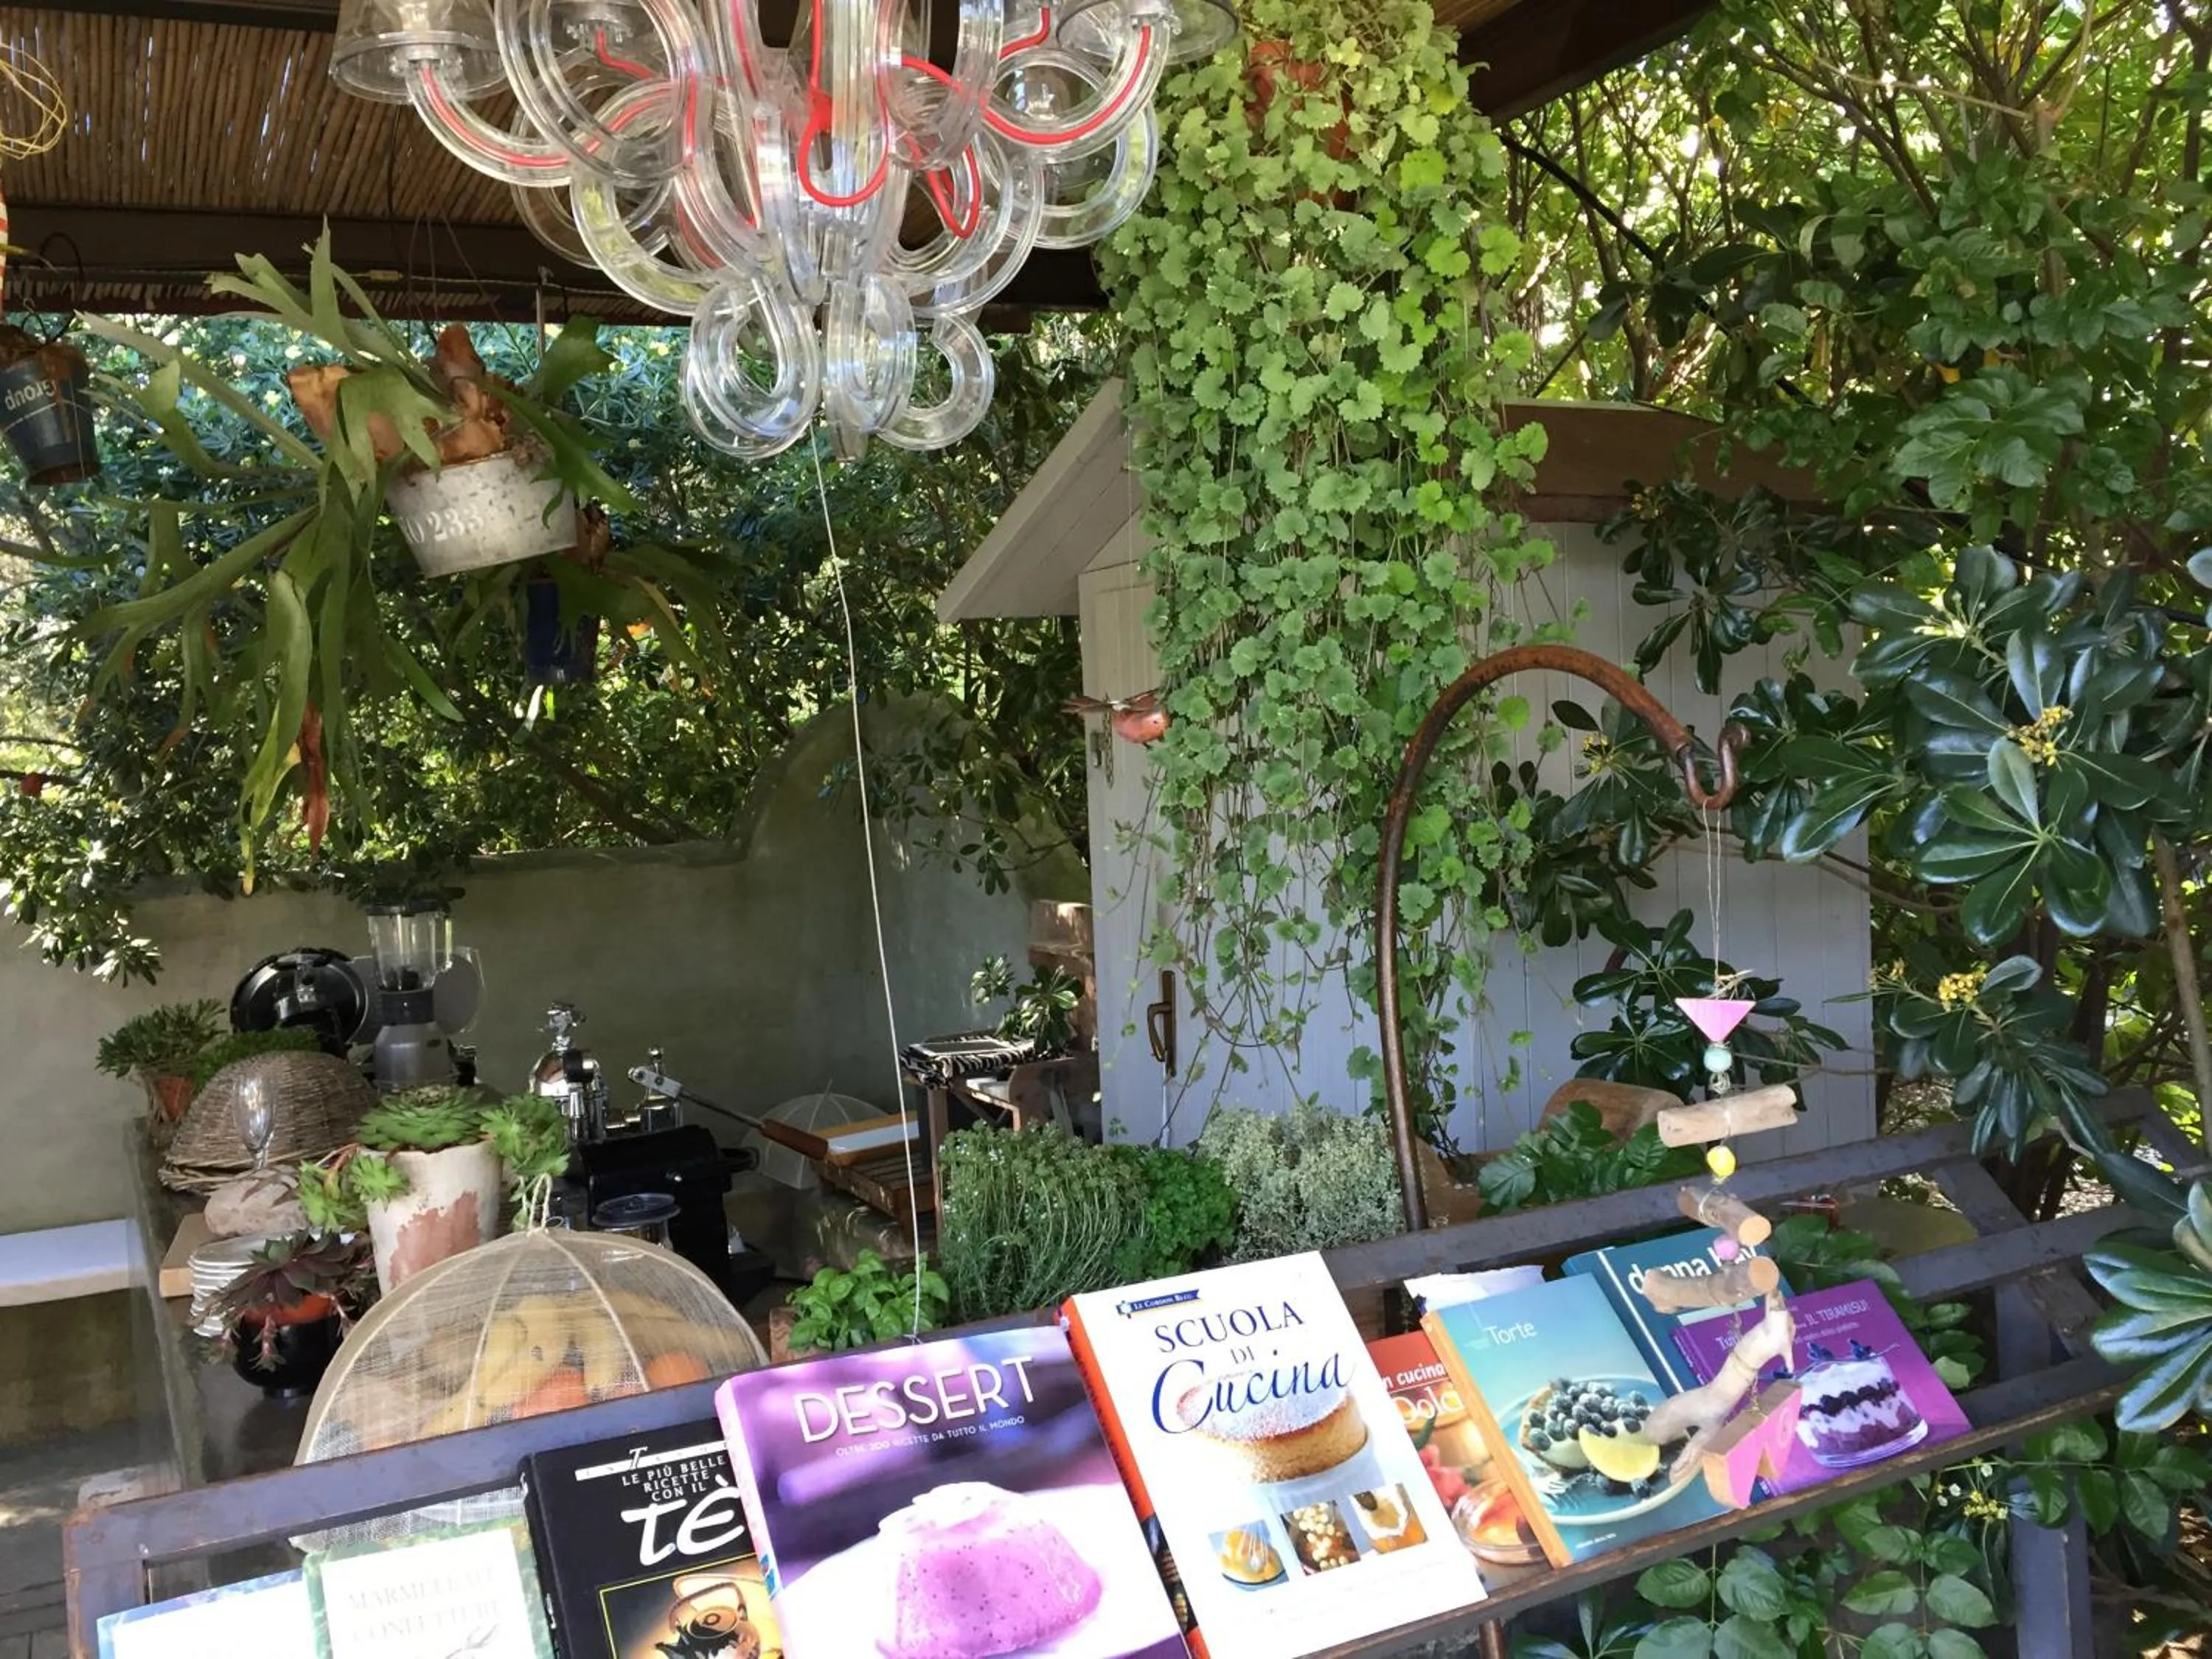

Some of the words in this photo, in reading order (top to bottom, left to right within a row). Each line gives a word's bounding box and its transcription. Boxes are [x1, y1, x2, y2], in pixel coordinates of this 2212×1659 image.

[4, 379, 58, 411] Group
[1628, 1263, 1713, 1295] dnna
[1154, 1301, 1304, 1353] SCUOLA
[1483, 1321, 1538, 1346] Torte
[1231, 1346, 1255, 1364] DI
[1397, 1362, 1446, 1386] cucina
[792, 1355, 1034, 1443] DESSERT
[1151, 1349, 1355, 1434] Cucina
[931, 1433, 945, 1442] DA
[946, 1425, 976, 1439] TUTTO
[989, 1416, 1025, 1430] MONDO
[622, 1473, 641, 1486] LE
[647, 1464, 672, 1481] PIÙ
[680, 1455, 726, 1474] BELLE
[643, 1470, 709, 1493] RICETTE
[651, 1486, 684, 1502] CON
[691, 1481, 707, 1493] IL
